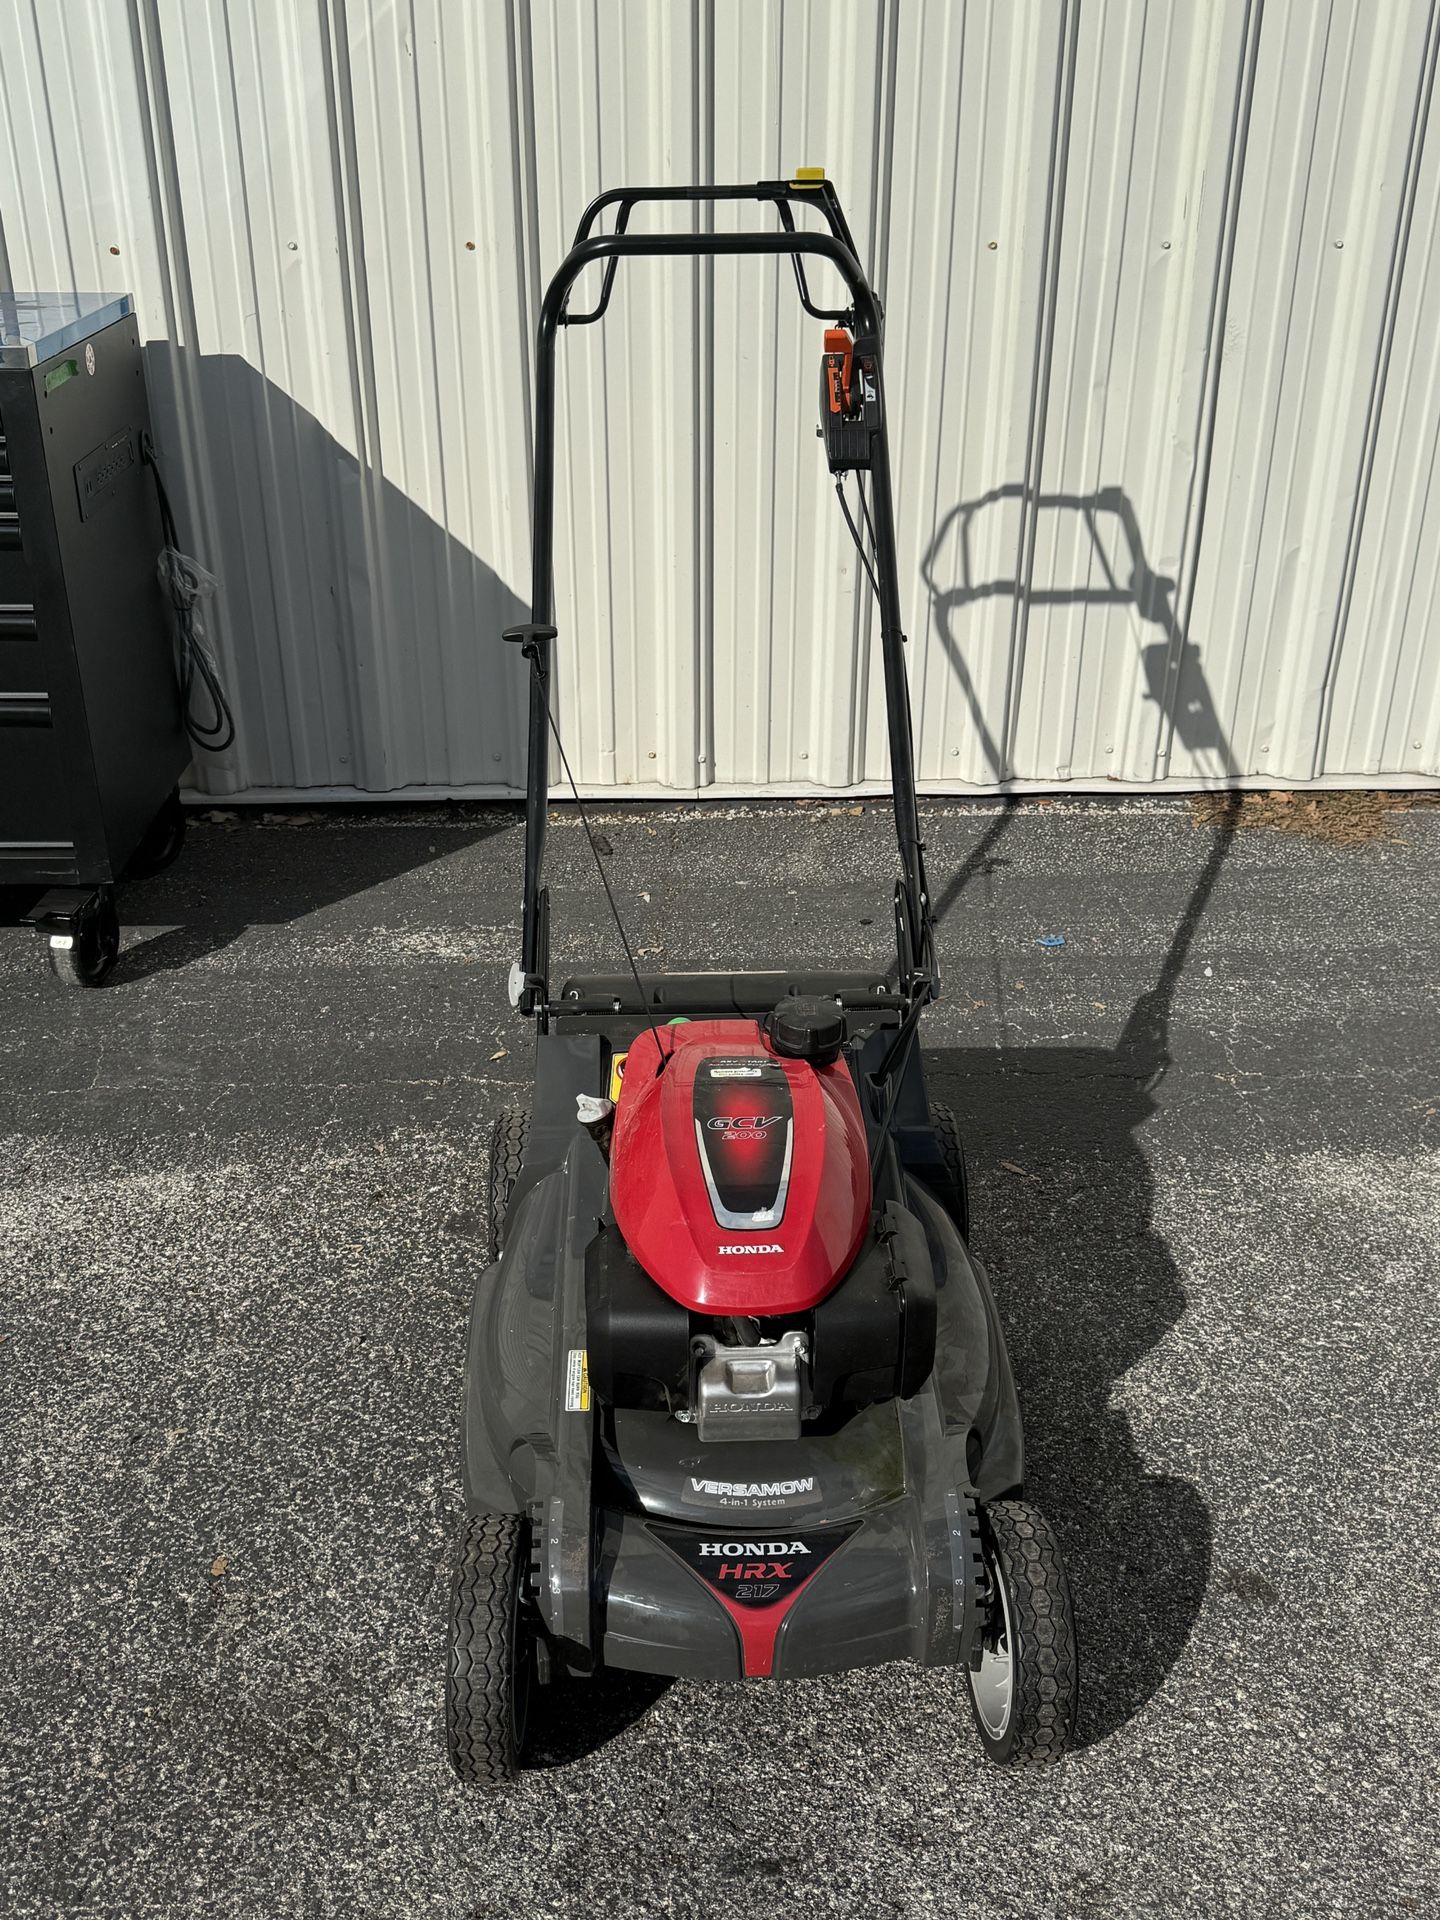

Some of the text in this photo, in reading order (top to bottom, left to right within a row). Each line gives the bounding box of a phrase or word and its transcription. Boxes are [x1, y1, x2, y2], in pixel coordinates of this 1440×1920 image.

[707, 1116, 783, 1130] GCV
[722, 1131, 767, 1140] 200
[718, 1244, 784, 1255] HONDA
[709, 1403, 793, 1413] HONDA
[691, 1478, 814, 1497] VERSAMOW
[720, 1498, 786, 1508] 4-in-1 System
[699, 1542, 812, 1556] HONDA
[719, 1562, 794, 1579] HRX
[955, 1578, 964, 1586] 3
[735, 1584, 780, 1598] 217
